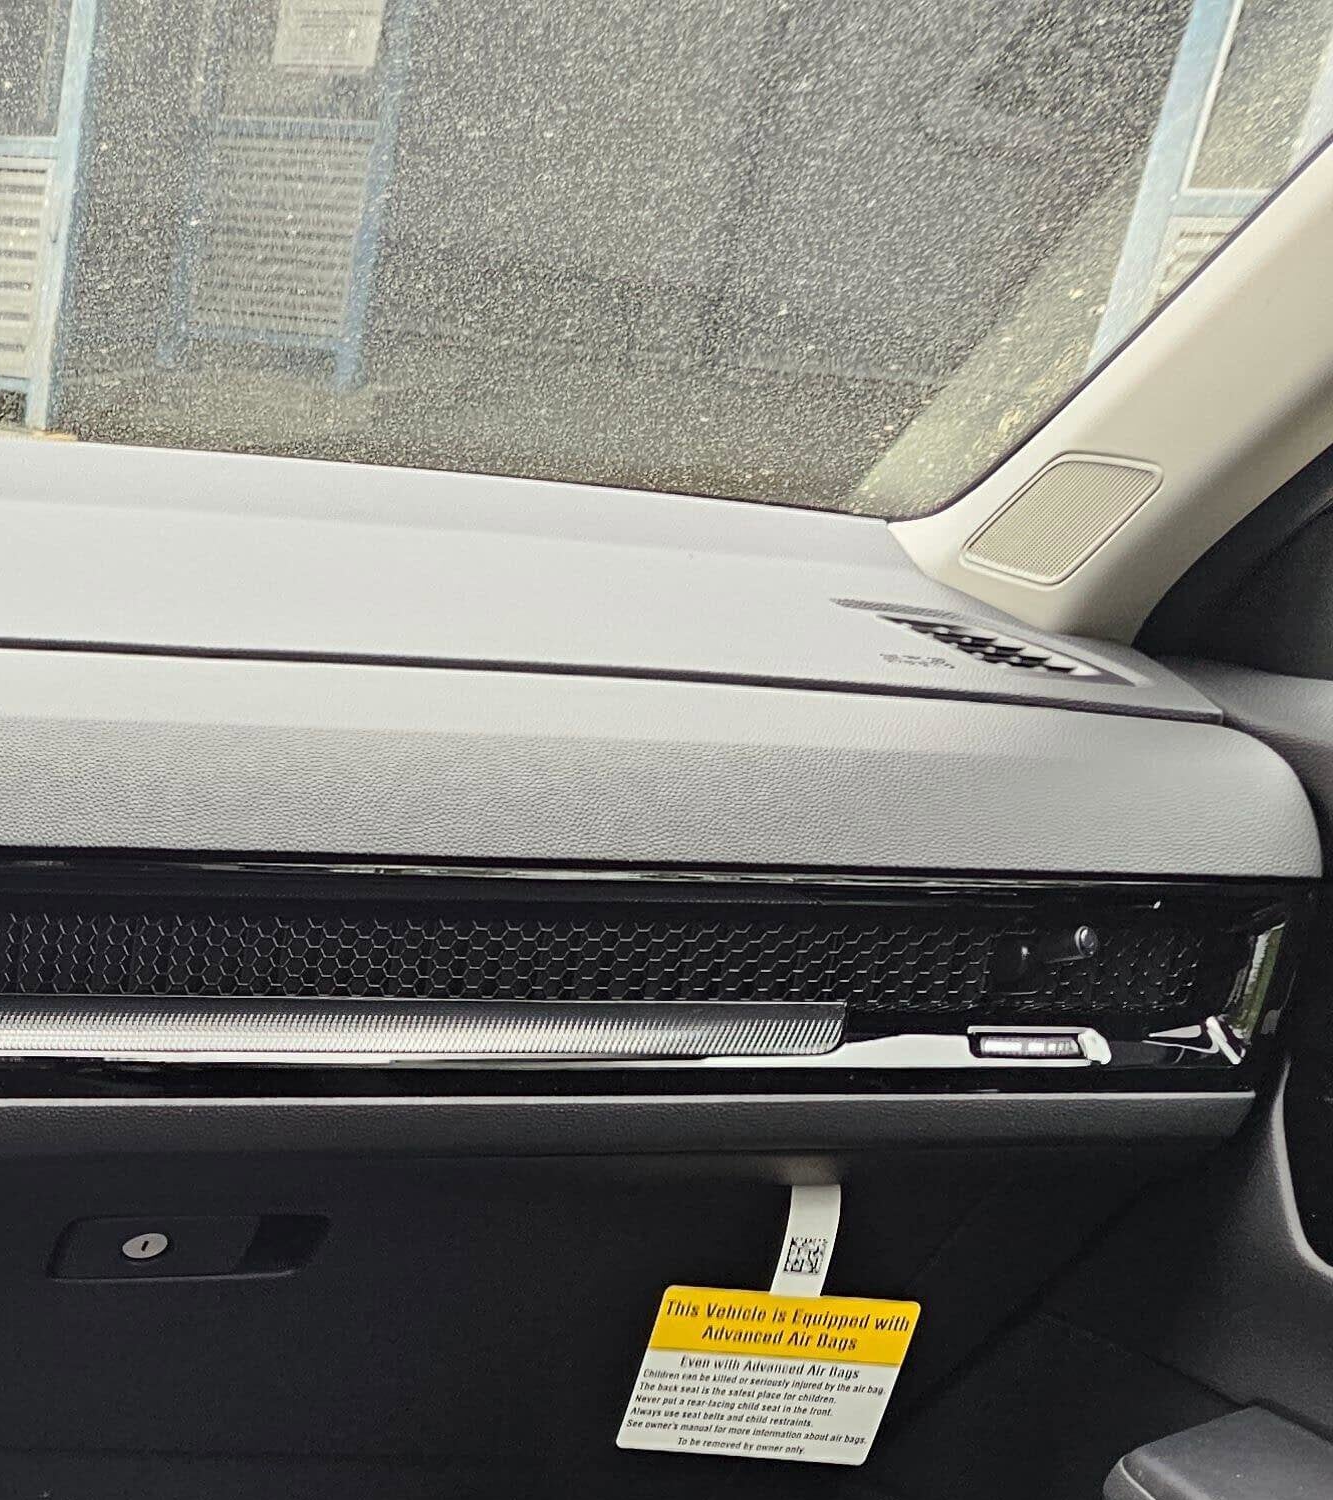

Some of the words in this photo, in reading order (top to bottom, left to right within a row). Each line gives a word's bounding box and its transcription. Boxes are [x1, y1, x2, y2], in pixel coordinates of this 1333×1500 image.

[667, 1300, 700, 1317] This
[707, 1302, 766, 1320] Vehicle
[772, 1307, 786, 1322] is
[792, 1308, 870, 1330] Equipped
[874, 1315, 910, 1331] with
[701, 1324, 784, 1344] Advanced
[787, 1331, 812, 1347] Air
[817, 1333, 857, 1352] Bags
[680, 1354, 710, 1368] Even
[714, 1359, 740, 1370] with
[743, 1360, 805, 1376] Advanced
[807, 1365, 826, 1376] Air
[829, 1366, 860, 1380] Bags
[643, 1368, 679, 1379] Children
[700, 1373, 710, 1381] be
[713, 1374, 737, 1383] killed
[750, 1378, 790, 1388] seriously
[791, 1380, 822, 1391] injured
[825, 1382, 835, 1392] by
[837, 1383, 851, 1392] the
[853, 1385, 866, 1393] air
[867, 1386, 886, 1395] bag.
[640, 1382, 655, 1390] The
[658, 1383, 678, 1392] back
[681, 1385, 700, 1393] seat
[729, 1388, 755, 1397] safest
[757, 1391, 781, 1400] place
[784, 1392, 796, 1400] for
[798, 1393, 837, 1404] children.
[635, 1395, 661, 1403] Never
[662, 1397, 677, 1405] put
[687, 1399, 735, 1409] rear-facing
[738, 1401, 759, 1410] child
[762, 1404, 780, 1412] seat
[794, 1406, 807, 1414] the
[630, 1407, 661, 1417] Always
[703, 1412, 724, 1420] belts
[727, 1414, 744, 1422] and
[746, 1416, 767, 1424] child
[770, 1418, 813, 1427] restraints.
[645, 1422, 678, 1430] owner's
[714, 1425, 726, 1433] for
[752, 1428, 802, 1438] information
[804, 1432, 829, 1441] about
[844, 1434, 867, 1444] bags.
[678, 1437, 687, 1445] To
[690, 1438, 700, 1446] be
[703, 1440, 741, 1449] removed
[743, 1442, 753, 1450] by
[785, 1446, 805, 1454] only.
